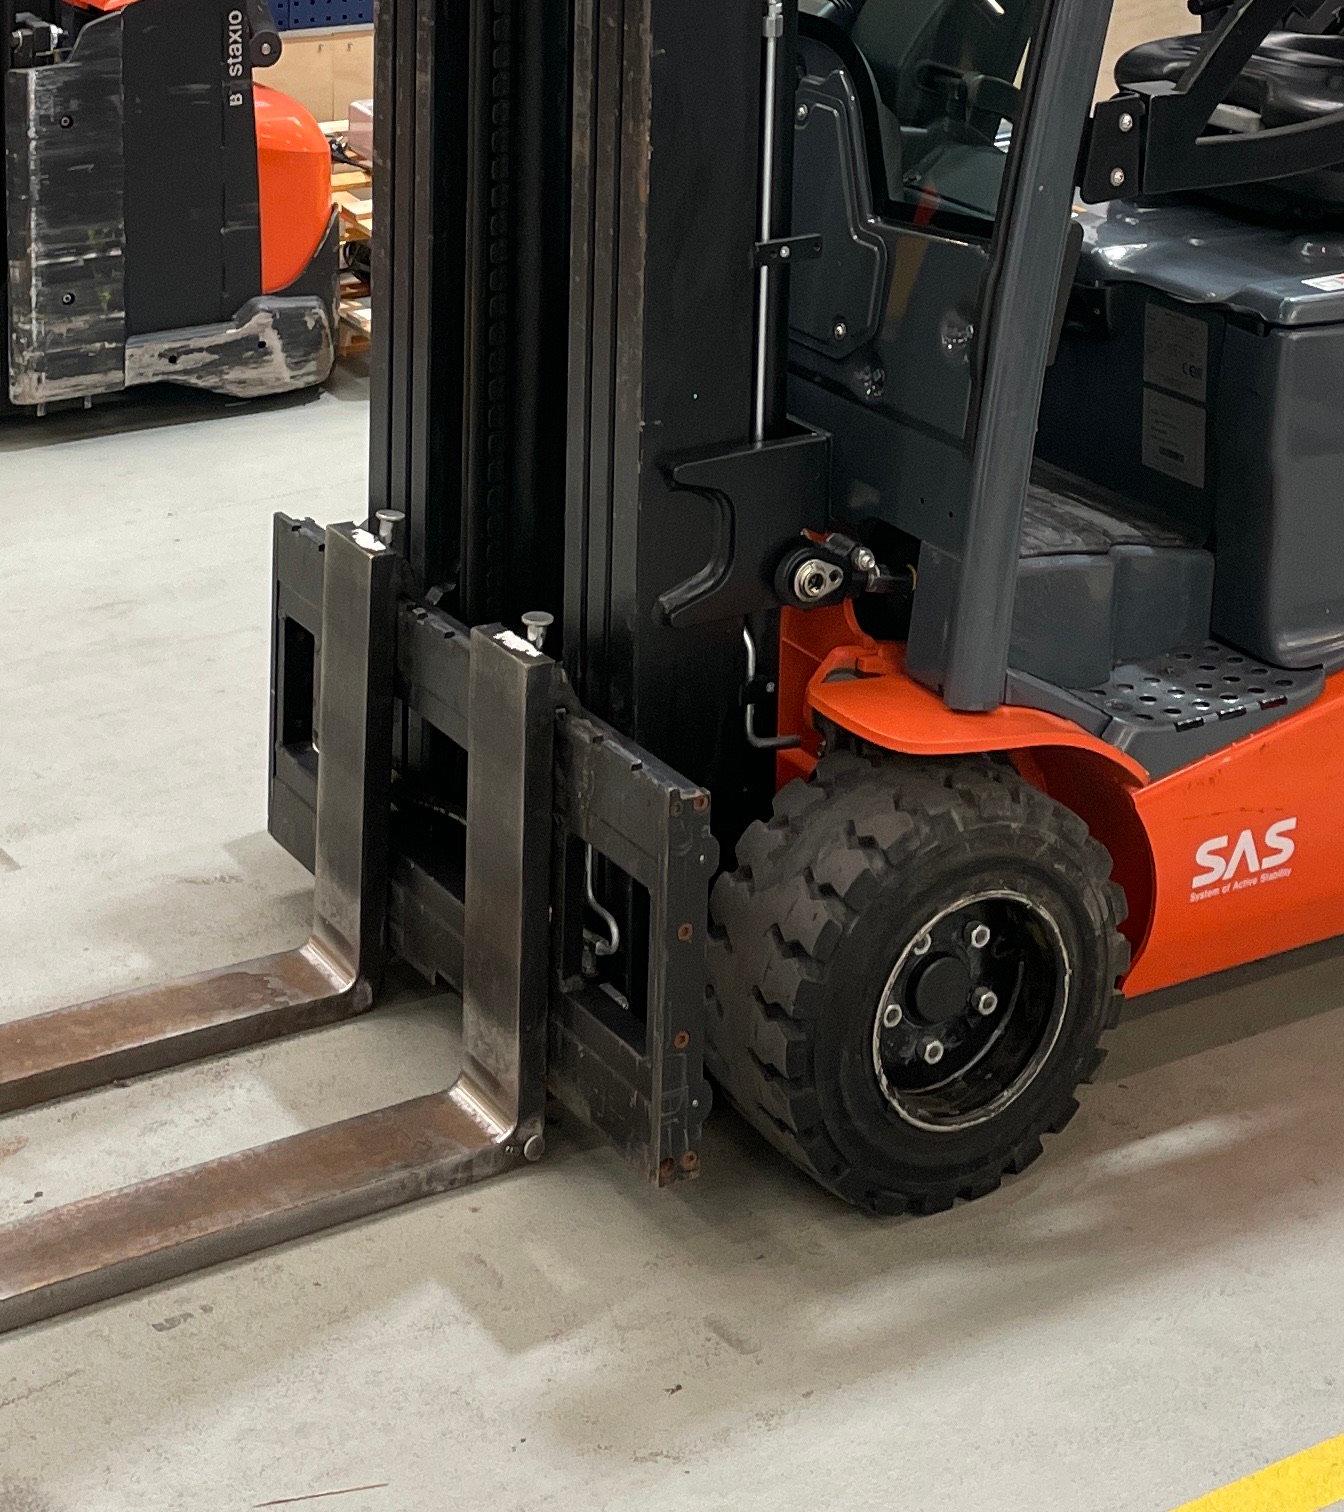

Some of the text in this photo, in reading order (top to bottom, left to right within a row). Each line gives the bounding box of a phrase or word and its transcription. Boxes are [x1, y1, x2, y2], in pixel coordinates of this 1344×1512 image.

[227, 9, 243, 77] staxio
[1189, 867, 1293, 903] System of Active Stability
[1191, 817, 1297, 889] SAS
